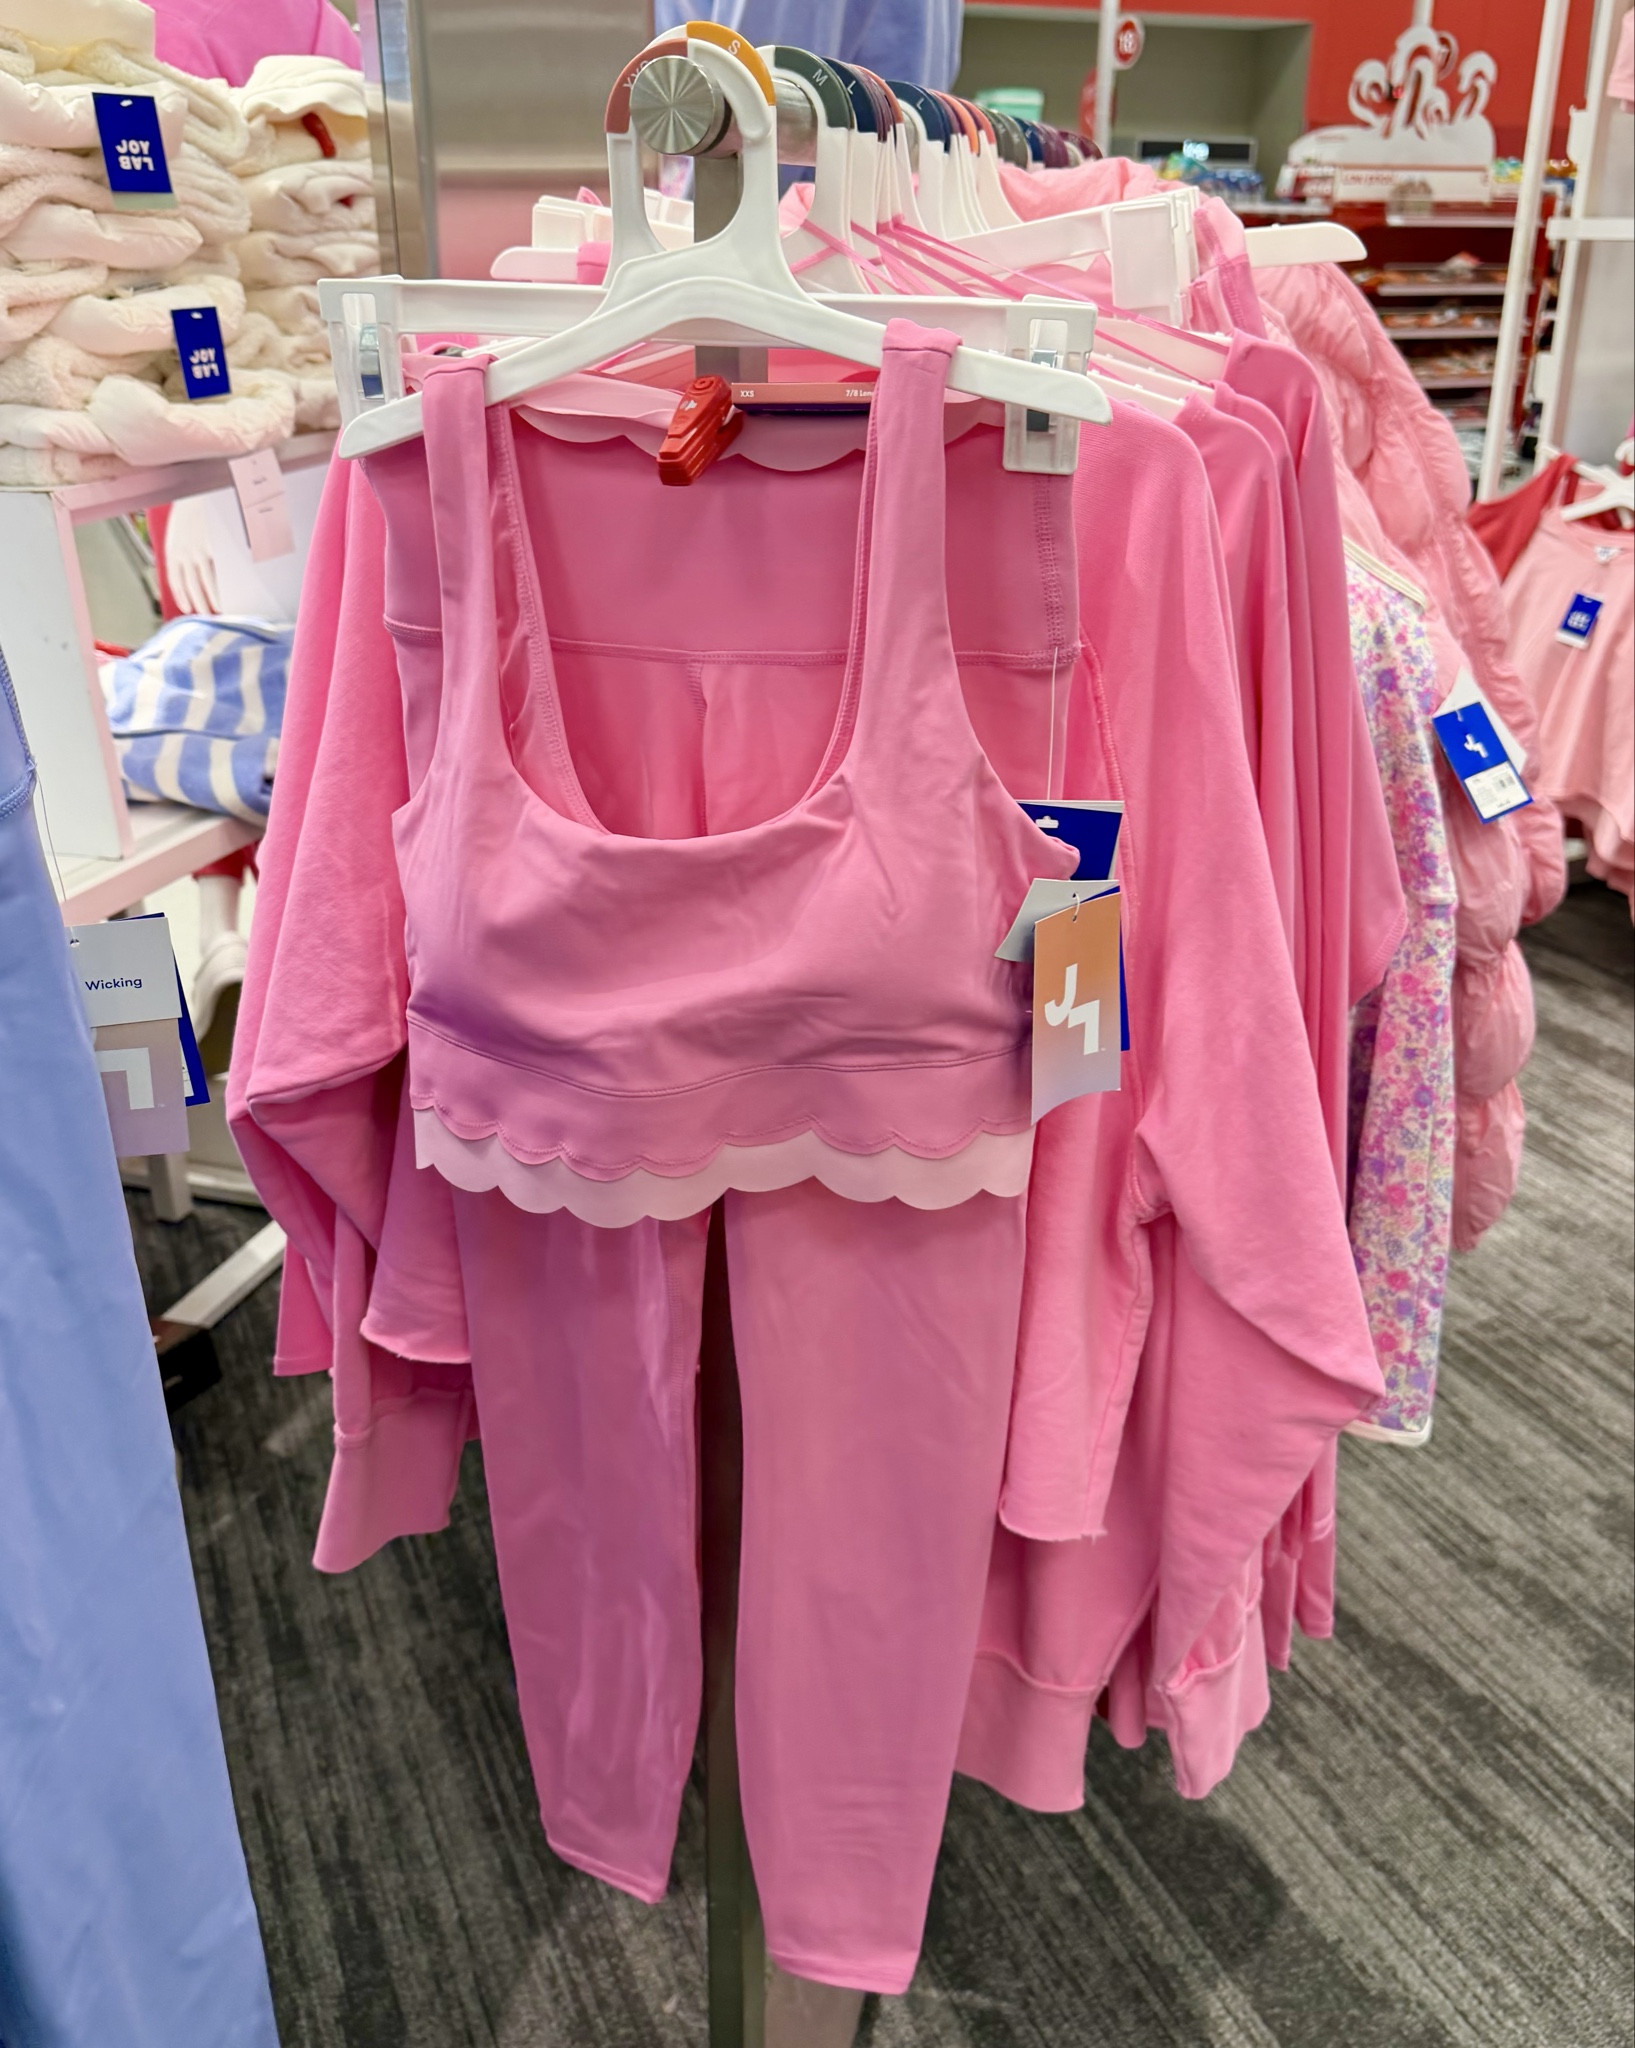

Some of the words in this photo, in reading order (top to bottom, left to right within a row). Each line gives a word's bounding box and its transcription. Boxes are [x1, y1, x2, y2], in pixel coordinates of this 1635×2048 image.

[728, 40, 740, 55] S
[812, 68, 828, 86] M
[847, 80, 856, 95] L
[115, 139, 150, 155] JOY
[846, 389, 859, 397] 7/8
[84, 977, 143, 991] Wicking
